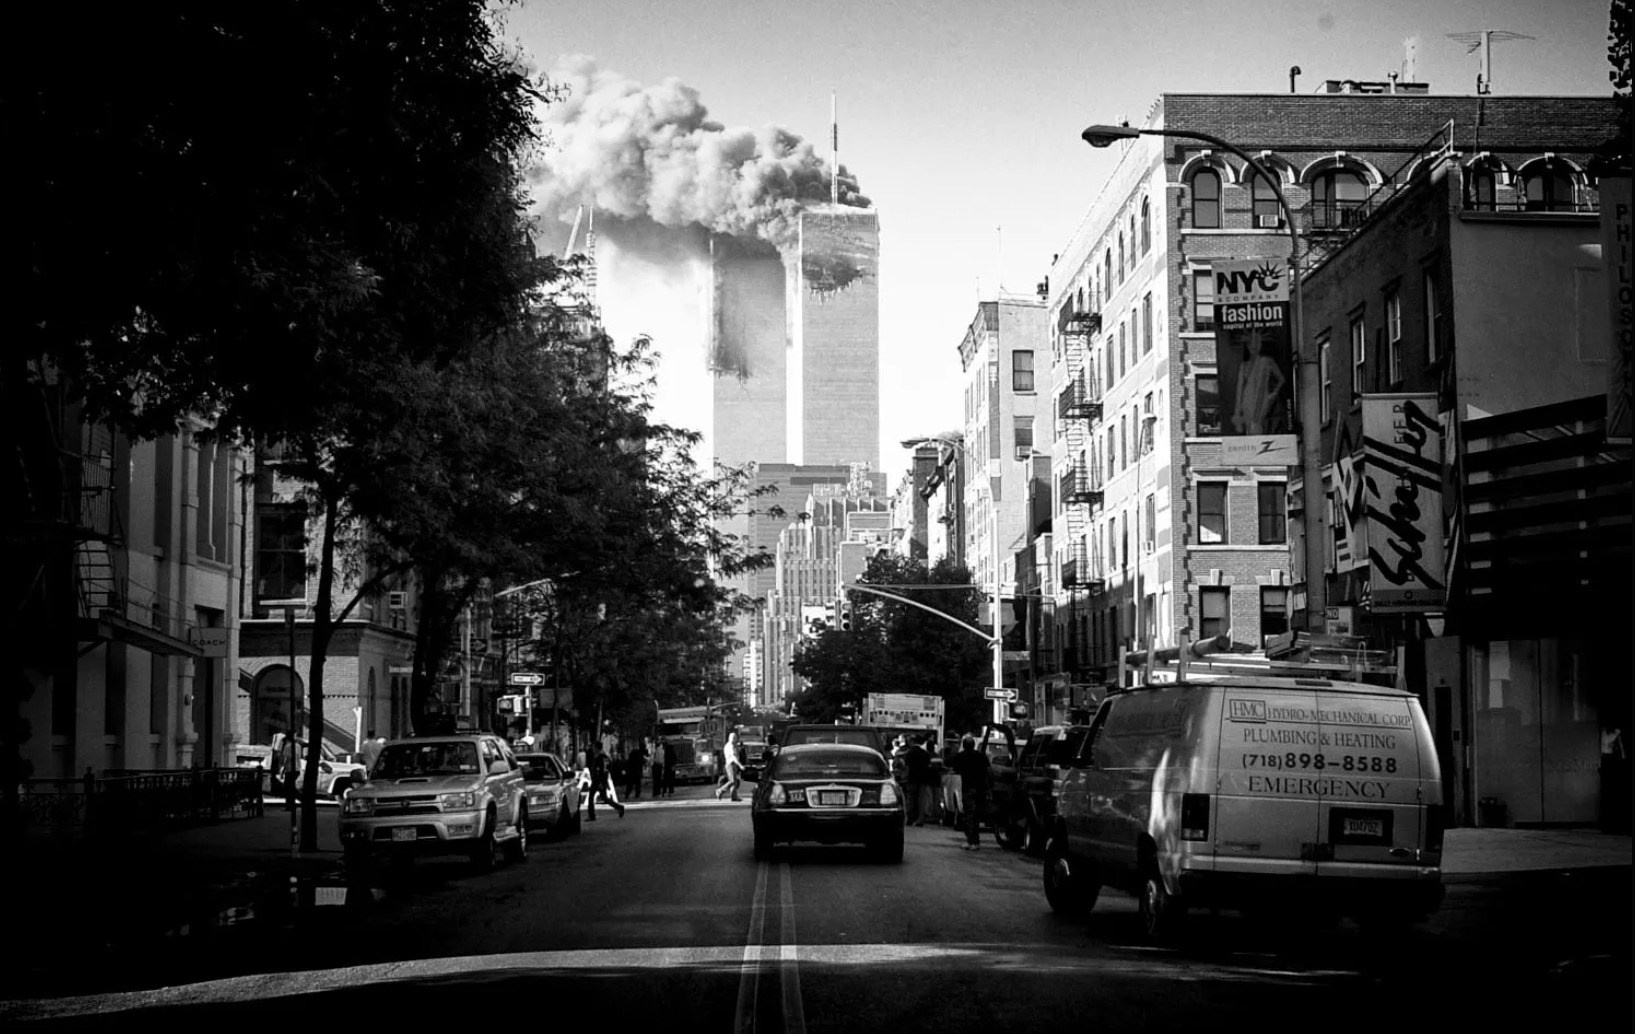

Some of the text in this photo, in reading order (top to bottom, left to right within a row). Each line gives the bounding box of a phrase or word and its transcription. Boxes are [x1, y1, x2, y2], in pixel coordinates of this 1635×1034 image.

[1216, 264, 1282, 294] NYC
[1225, 294, 1279, 302] COMPANY
[1222, 303, 1283, 322] fashion
[1233, 701, 1264, 717] HMC
[1243, 728, 1396, 749] PLUMBING & HEATING
[1248, 775, 1391, 799] EMERGENCY
